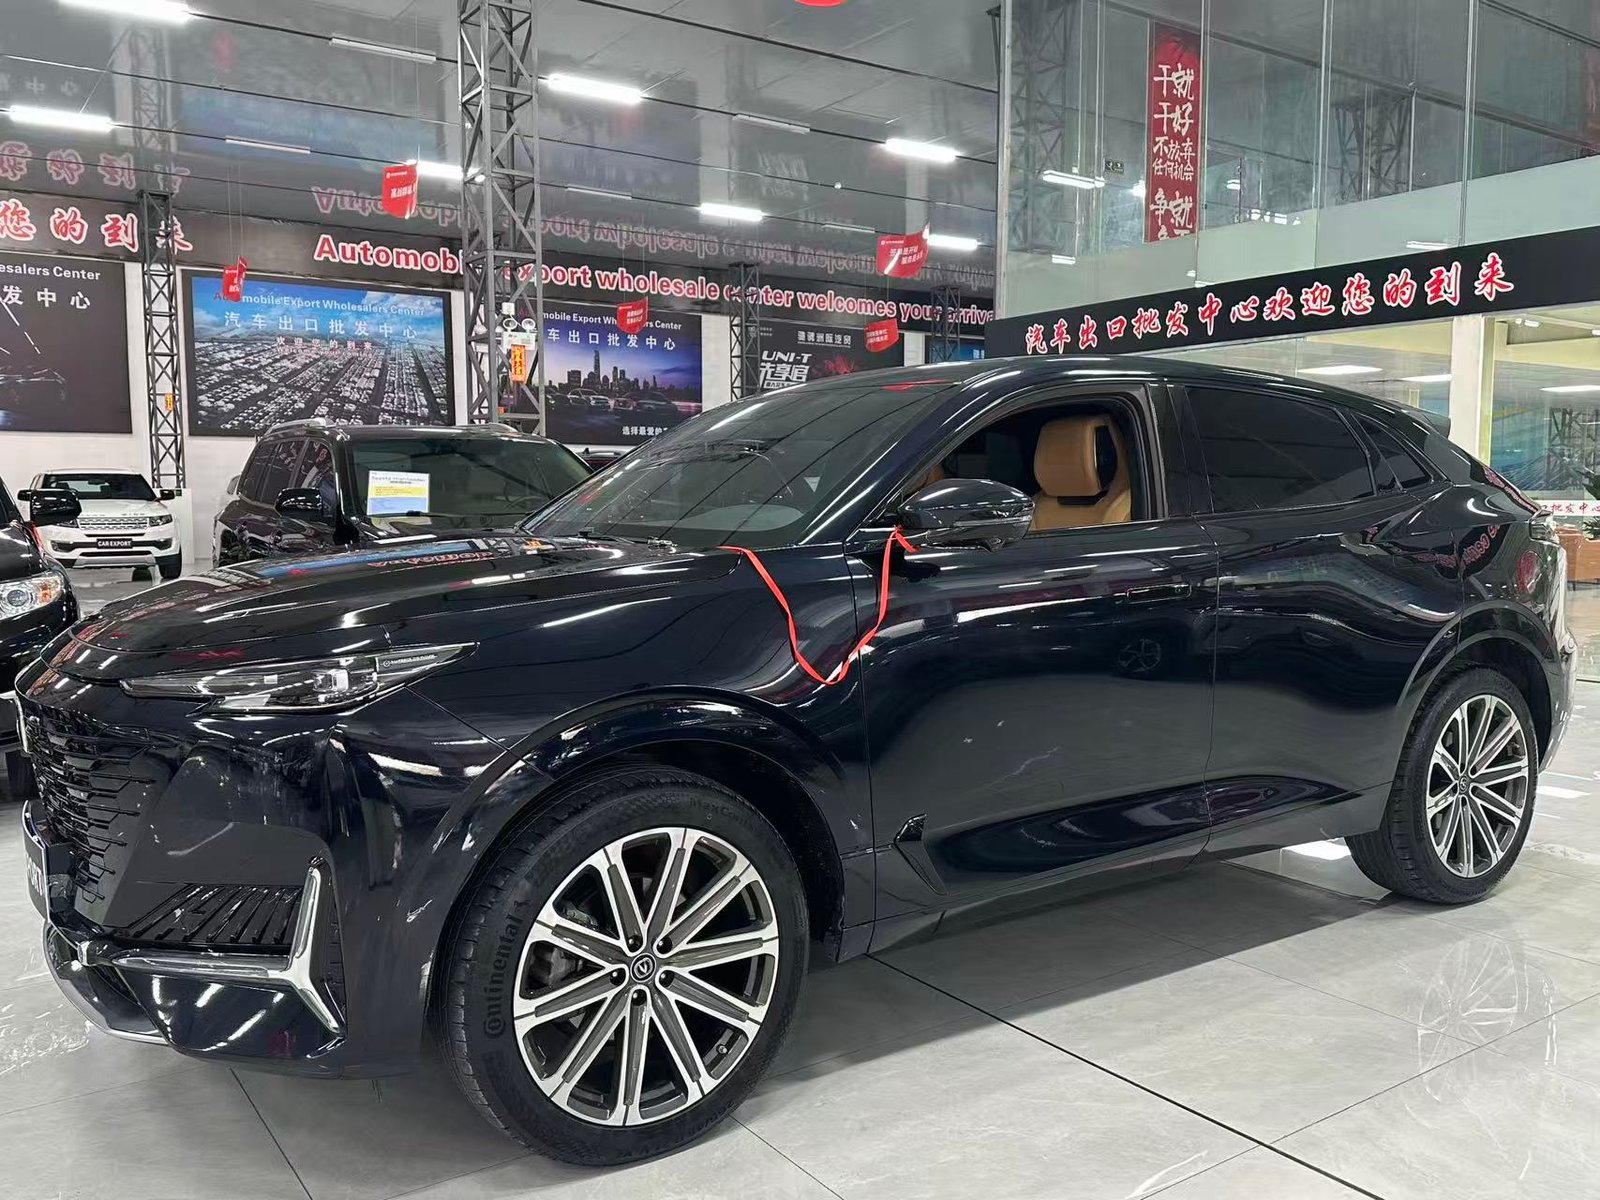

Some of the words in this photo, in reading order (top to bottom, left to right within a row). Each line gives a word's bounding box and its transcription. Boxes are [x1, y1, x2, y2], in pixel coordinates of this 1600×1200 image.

[53, 266, 101, 281] Center
[283, 296, 321, 309] Export
[322, 299, 388, 314] Wholesalers
[390, 305, 425, 316] Center
[595, 268, 720, 301] wholesale
[797, 290, 897, 318] welcomes
[899, 302, 942, 323] your
[1025, 251, 1515, 355] 汽车出口批发中心欢迎您的到来
[224, 310, 418, 340] 汽车出口批发中心
[572, 312, 601, 325] Export
[655, 319, 682, 331] Center
